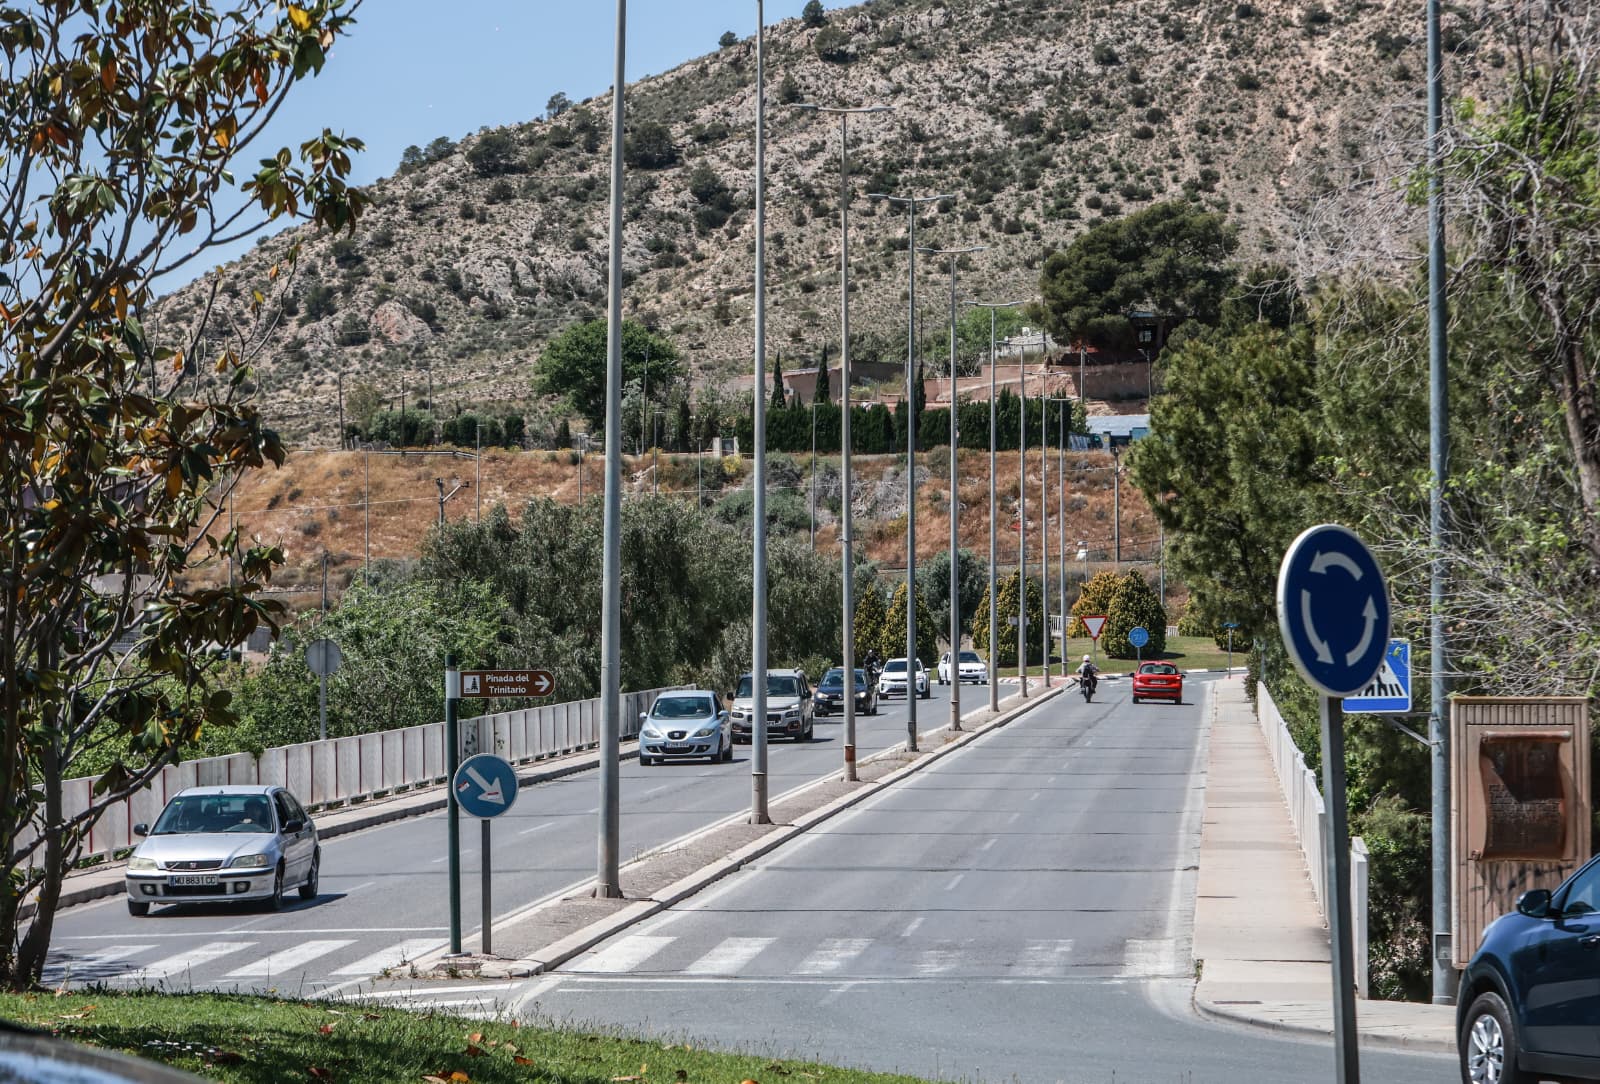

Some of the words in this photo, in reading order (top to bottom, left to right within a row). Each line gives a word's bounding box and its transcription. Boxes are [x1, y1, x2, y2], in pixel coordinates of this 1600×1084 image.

[486, 674, 514, 682] Pinada
[515, 674, 529, 682] del
[489, 686, 526, 694] Trinitario
